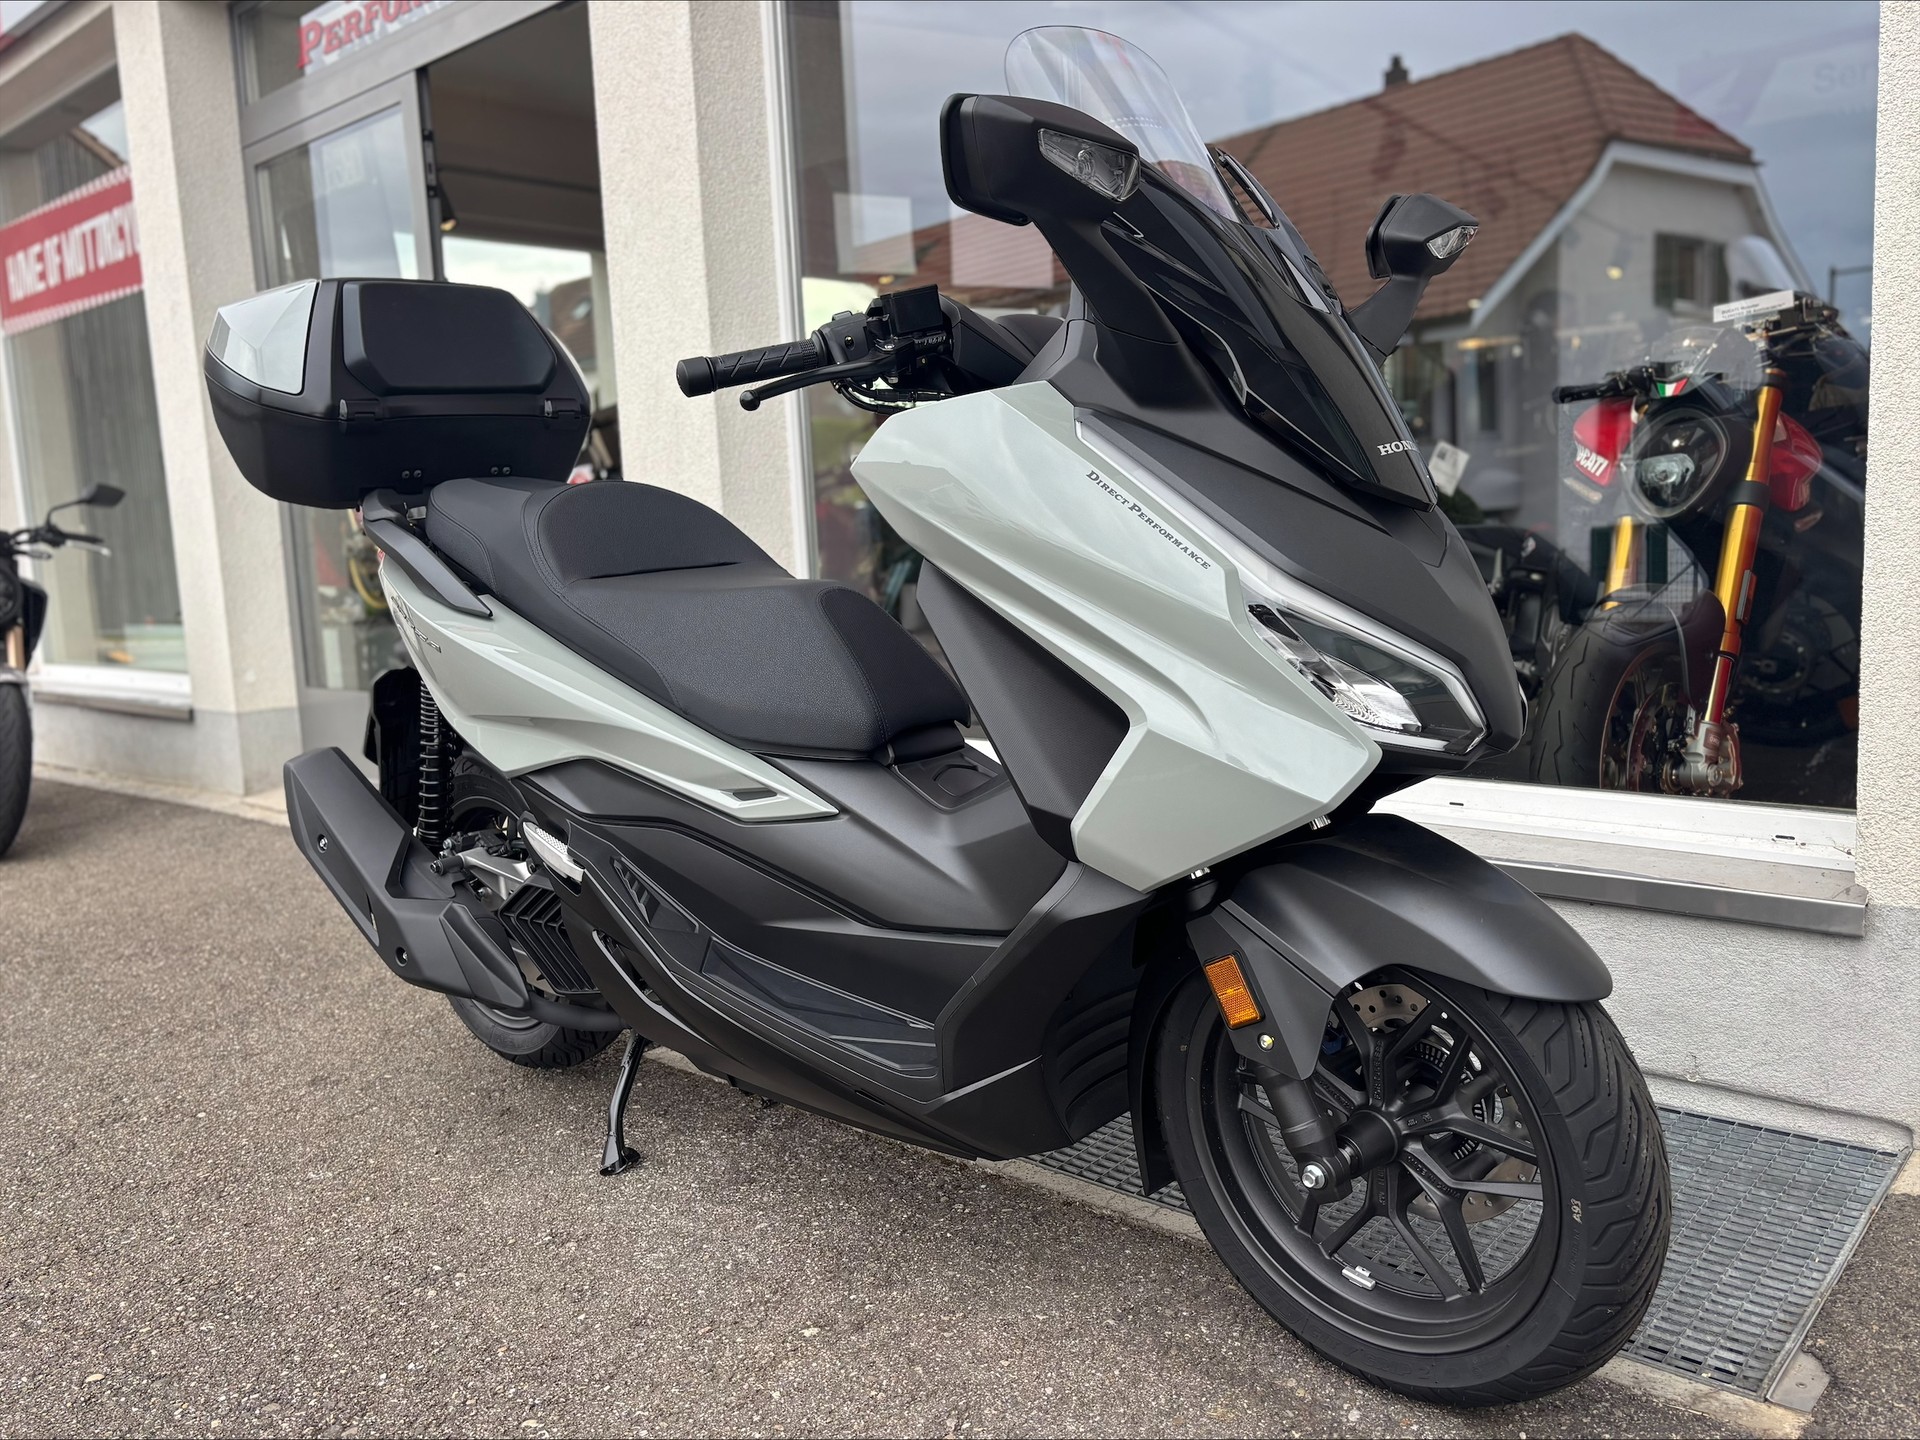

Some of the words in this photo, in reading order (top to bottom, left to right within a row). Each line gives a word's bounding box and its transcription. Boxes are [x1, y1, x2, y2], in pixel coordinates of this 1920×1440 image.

[44, 233, 62, 289] OF
[1086, 470, 1130, 505] DIRECT
[1128, 503, 1211, 570] PERFORMANCE
